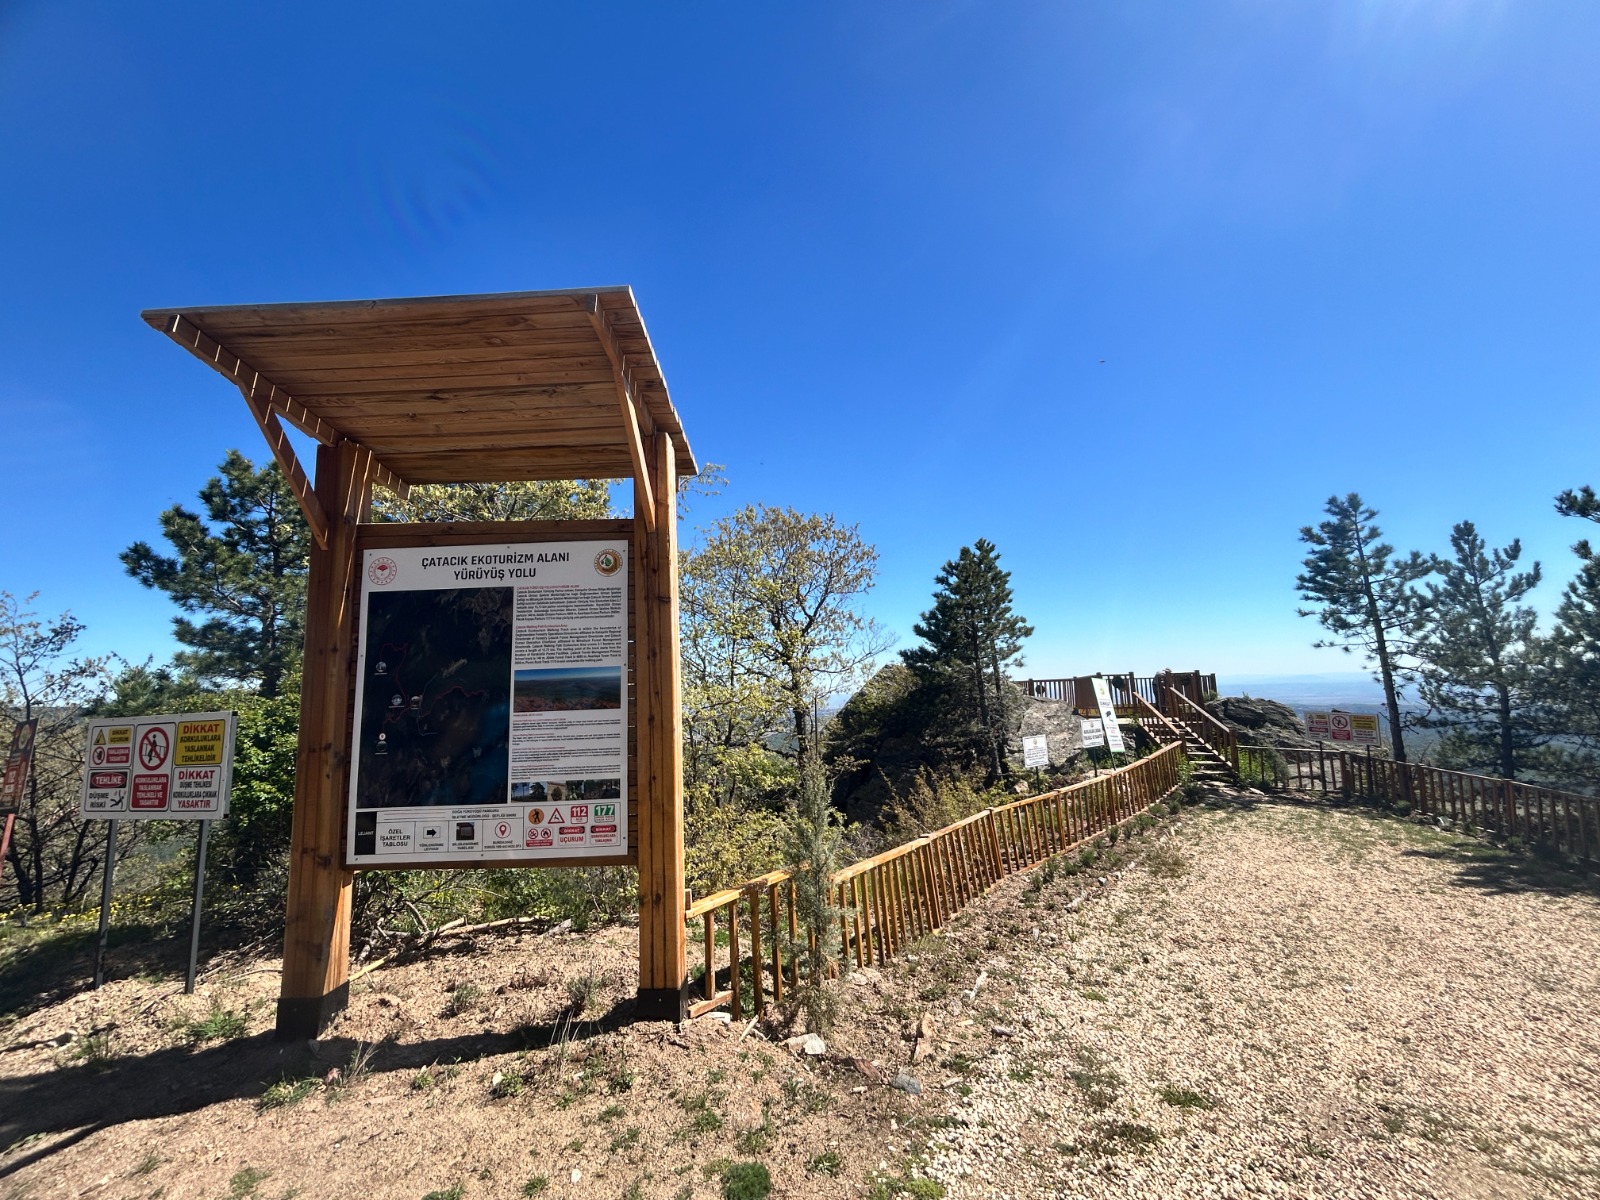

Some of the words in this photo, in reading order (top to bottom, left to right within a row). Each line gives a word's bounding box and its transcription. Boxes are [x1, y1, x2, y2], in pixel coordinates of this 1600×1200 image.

[422, 557, 468, 569] ÇATACIK
[471, 552, 534, 565] EKOTURİZM
[537, 552, 570, 563] ALANI
[454, 568, 504, 580] YÜRÜYÜŞ
[508, 568, 536, 578] YOLU
[183, 724, 220, 734] DİKKAT
[180, 735, 220, 743] KORKULUKLARA
[182, 754, 216, 762] TEHLİKELİDİR
[178, 769, 214, 780] DİKKAT
[96, 775, 122, 784] TEHLİKE
[89, 792, 108, 800] DÜŞME
[178, 800, 210, 808] YASAKTIR
[572, 807, 586, 816] 112
[596, 806, 614, 816] 177
